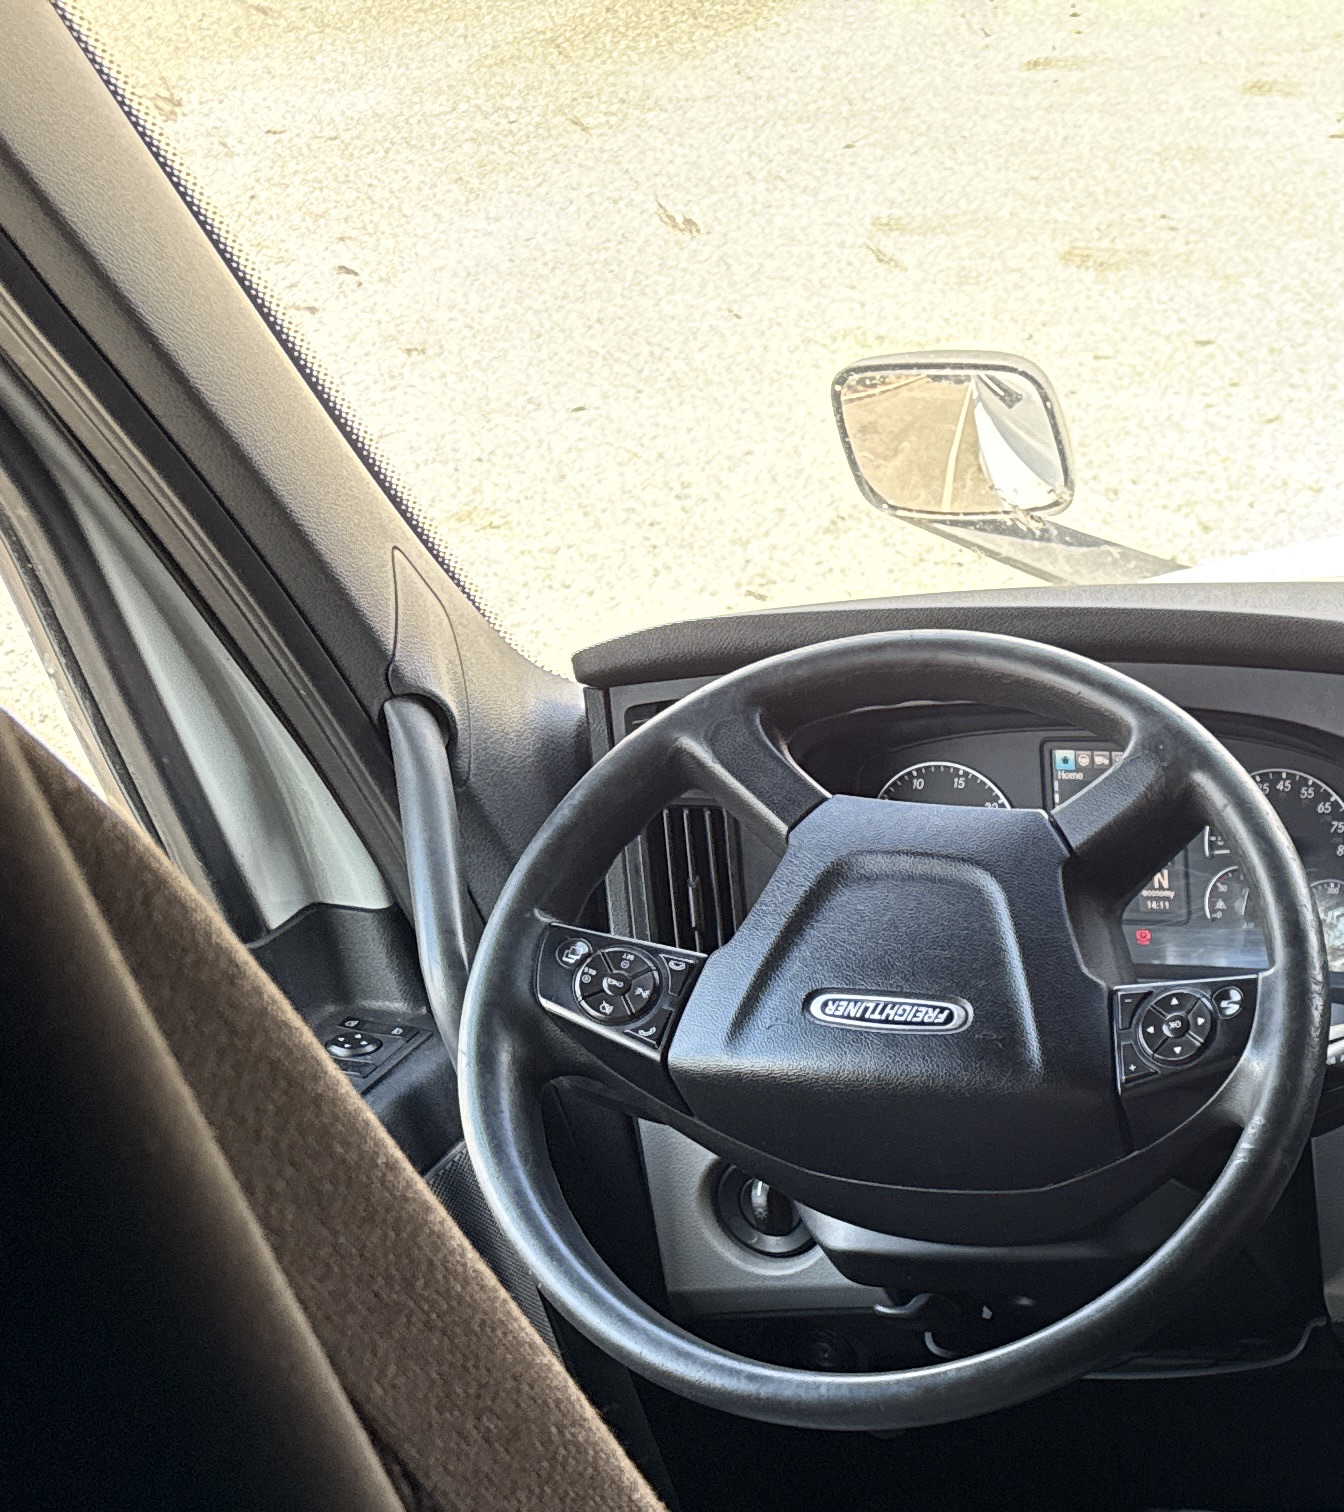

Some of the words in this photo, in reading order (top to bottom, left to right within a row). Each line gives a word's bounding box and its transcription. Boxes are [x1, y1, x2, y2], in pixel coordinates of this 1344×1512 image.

[1058, 771, 1083, 781] Home
[912, 778, 925, 790] 10
[953, 777, 966, 789] 15
[1276, 780, 1292, 792] 45
[1300, 787, 1315, 799] 55
[1317, 801, 1332, 814] 65
[1330, 821, 1344, 834] 75
[1153, 869, 1169, 889] N
[824, 999, 950, 1024] FREIGHTLINER
